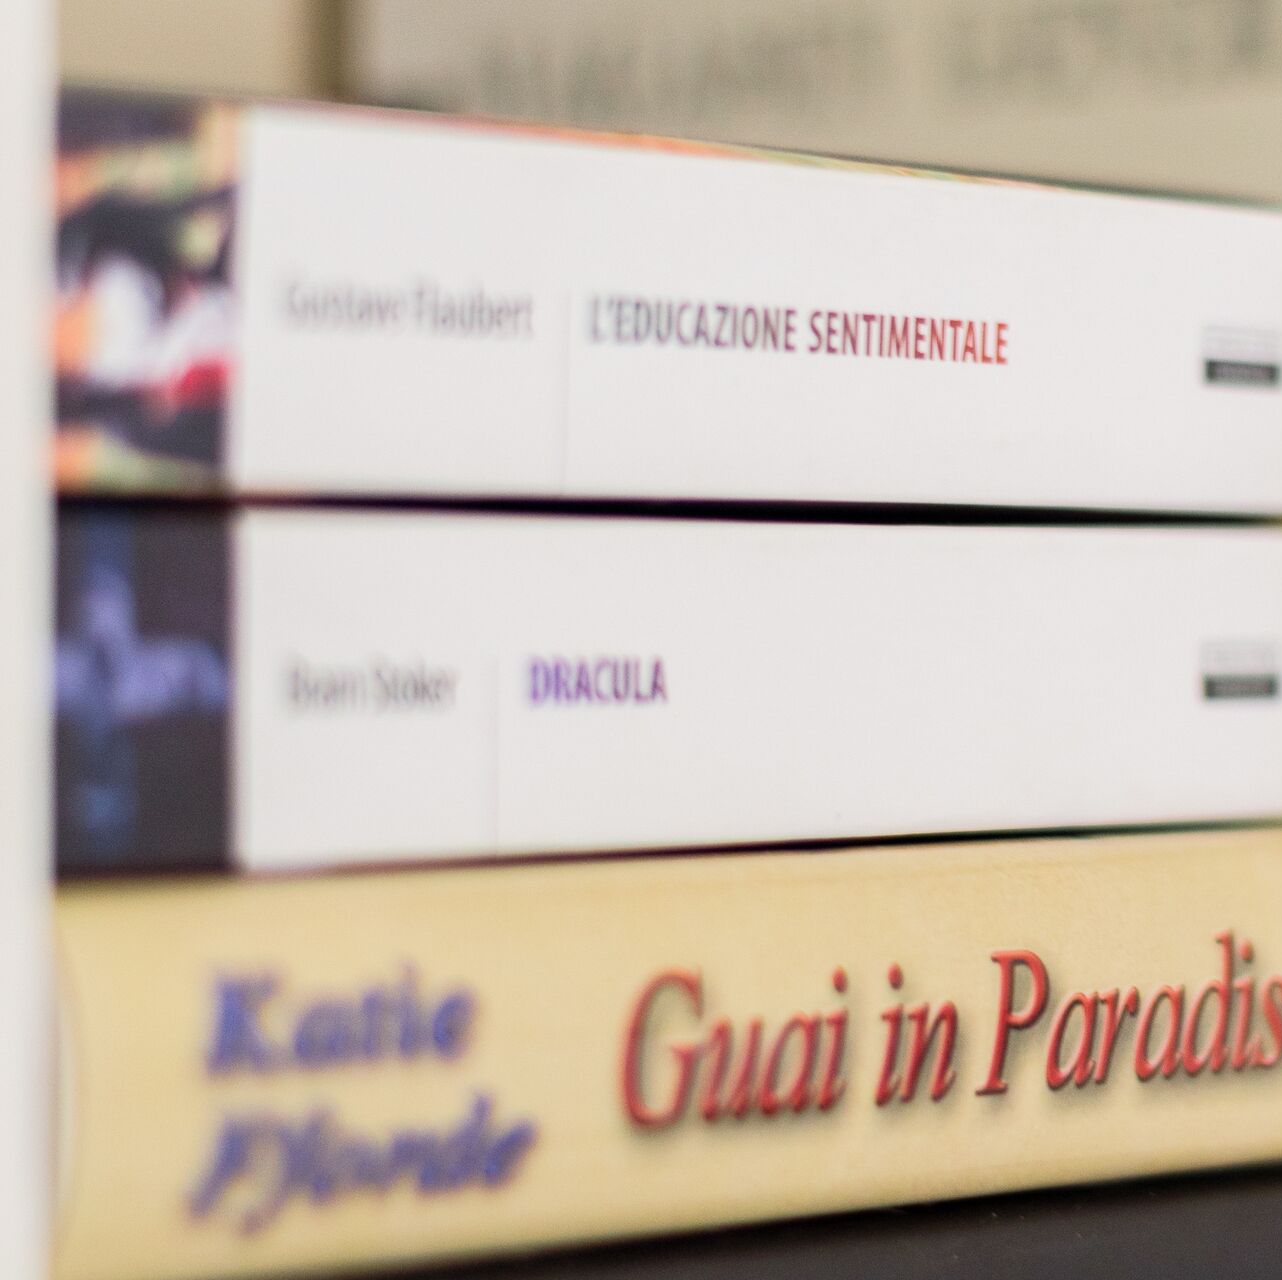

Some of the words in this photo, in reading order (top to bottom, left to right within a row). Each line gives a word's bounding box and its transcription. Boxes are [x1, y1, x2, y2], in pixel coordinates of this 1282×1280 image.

[283, 276, 408, 330] Gustave
[411, 278, 535, 339] Flaubert
[587, 295, 798, 353] L'EDUCAZIONE
[808, 310, 1009, 365] SENTIMENTALE
[372, 654, 460, 713] Stoker
[528, 656, 669, 705] DRACULA
[205, 955, 480, 1080] Katie
[619, 965, 852, 1132] Guai
[874, 962, 958, 1108] in
